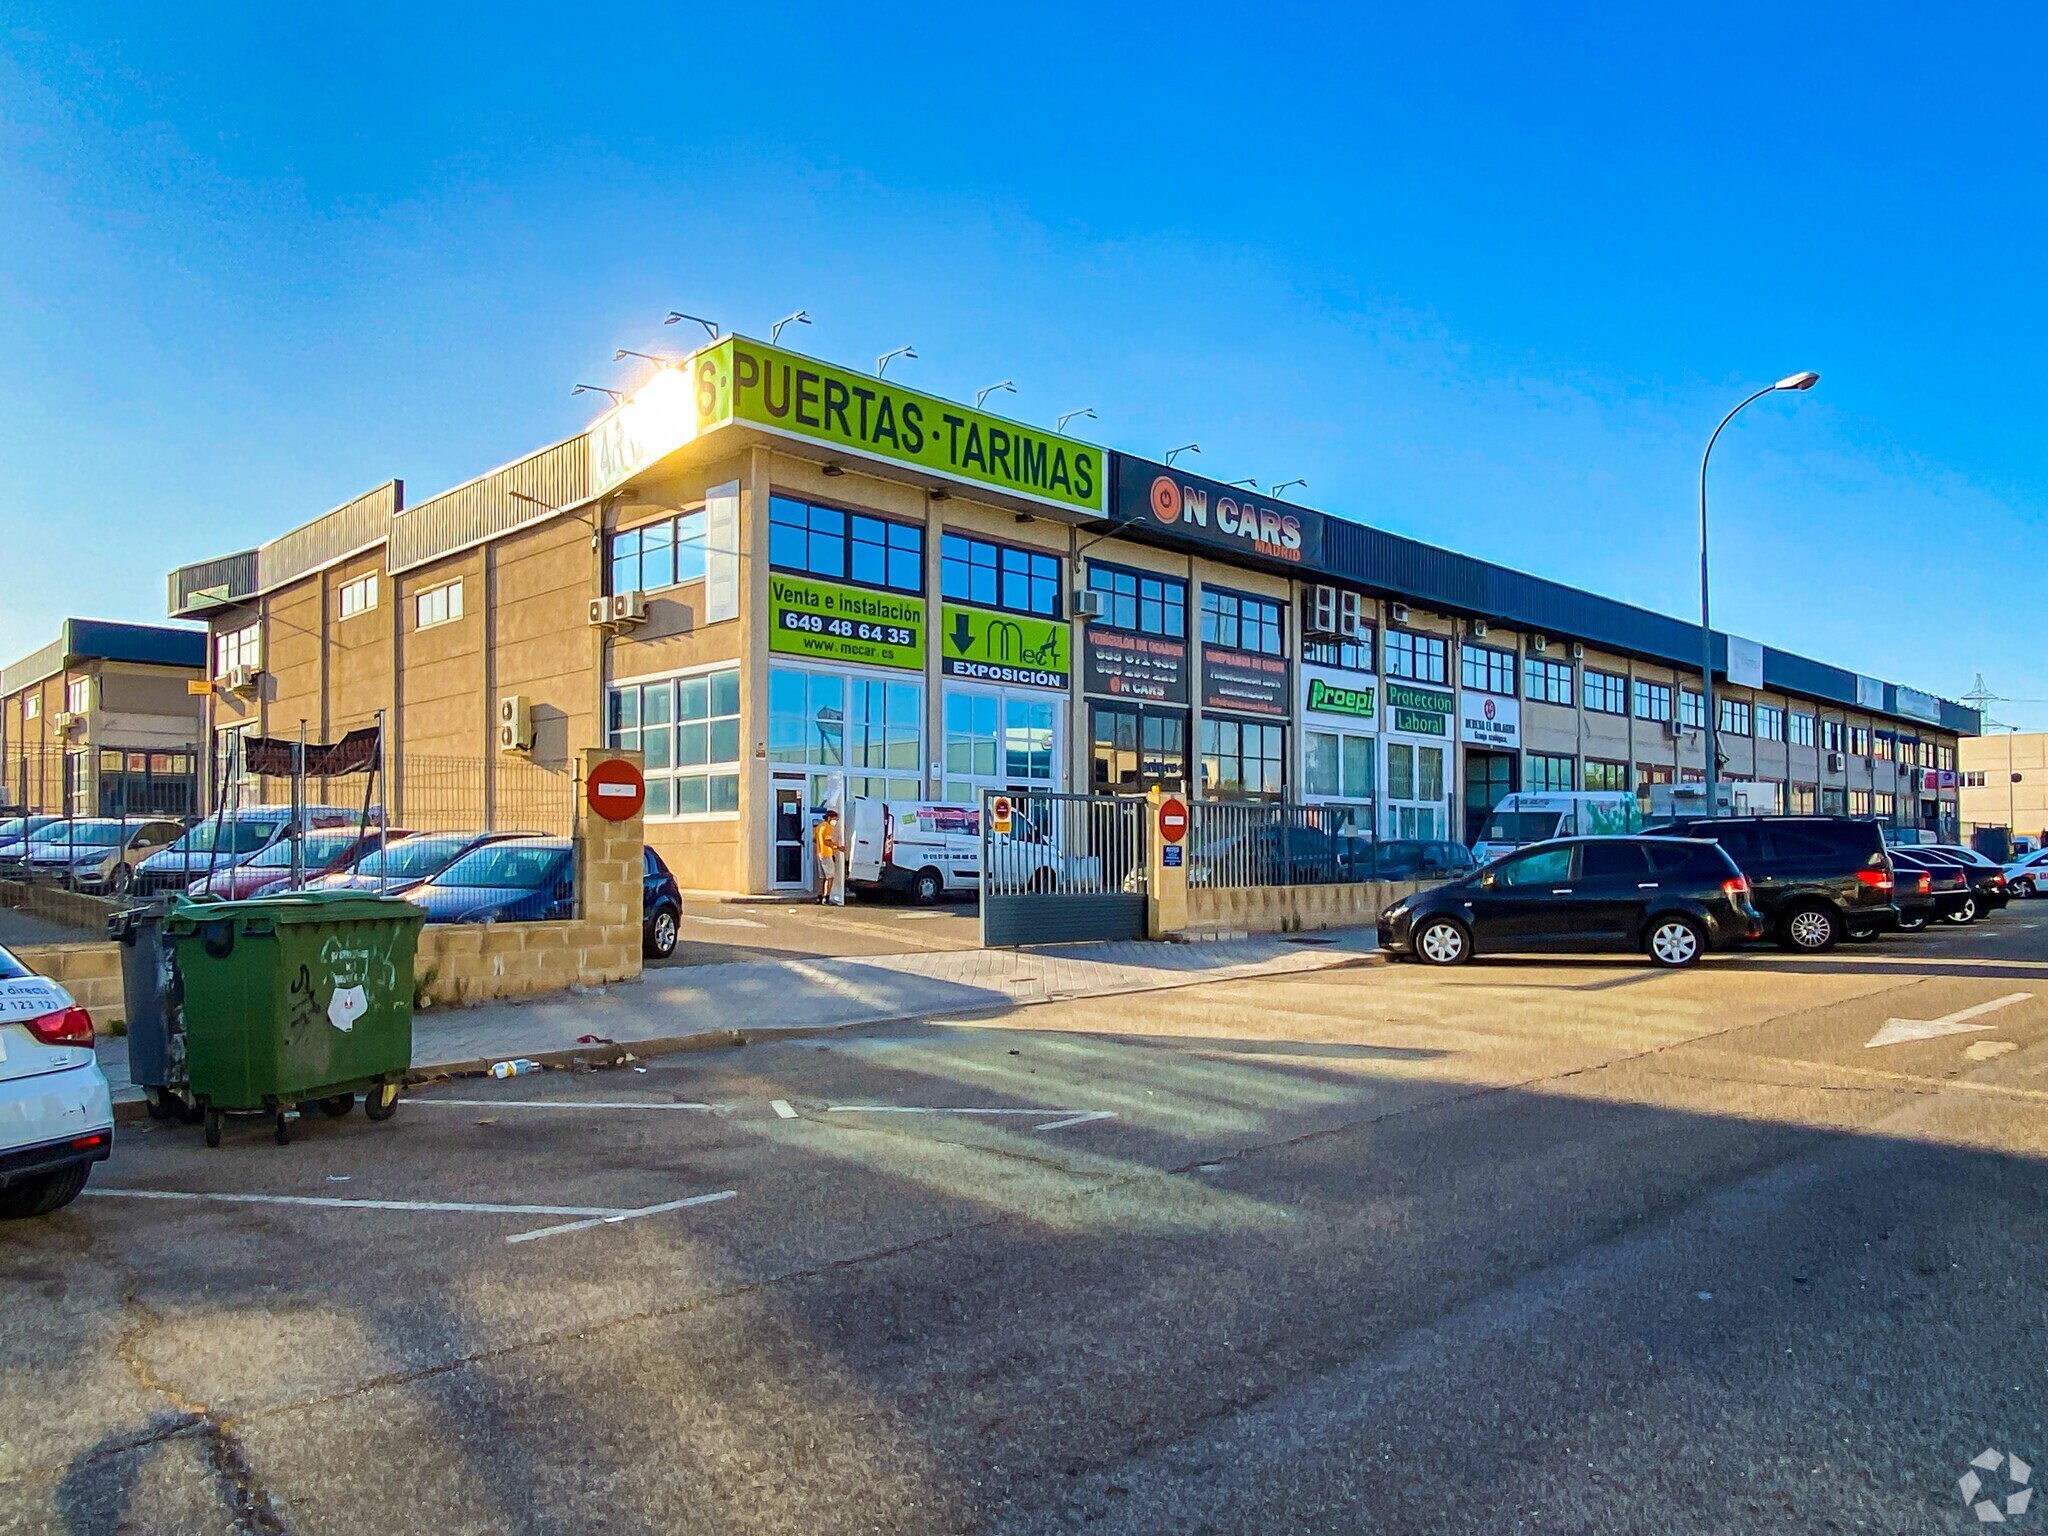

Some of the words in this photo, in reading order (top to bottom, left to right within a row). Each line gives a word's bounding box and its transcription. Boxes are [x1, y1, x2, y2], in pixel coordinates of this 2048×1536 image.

[1216, 496, 1301, 550] CARS
[1254, 540, 1301, 562] MADRID
[772, 581, 819, 607] Venta
[825, 595, 834, 609] e
[839, 592, 920, 623] instalación
[785, 612, 823, 633] 649
[828, 619, 853, 637] 48
[858, 624, 882, 641] 64
[887, 628, 910, 645] 35
[953, 661, 1060, 687] EXPOSICIÓN
[1311, 680, 1374, 714] Proepi
[1398, 712, 1444, 734] Laboral
[10, 1000, 34, 1010] 123
